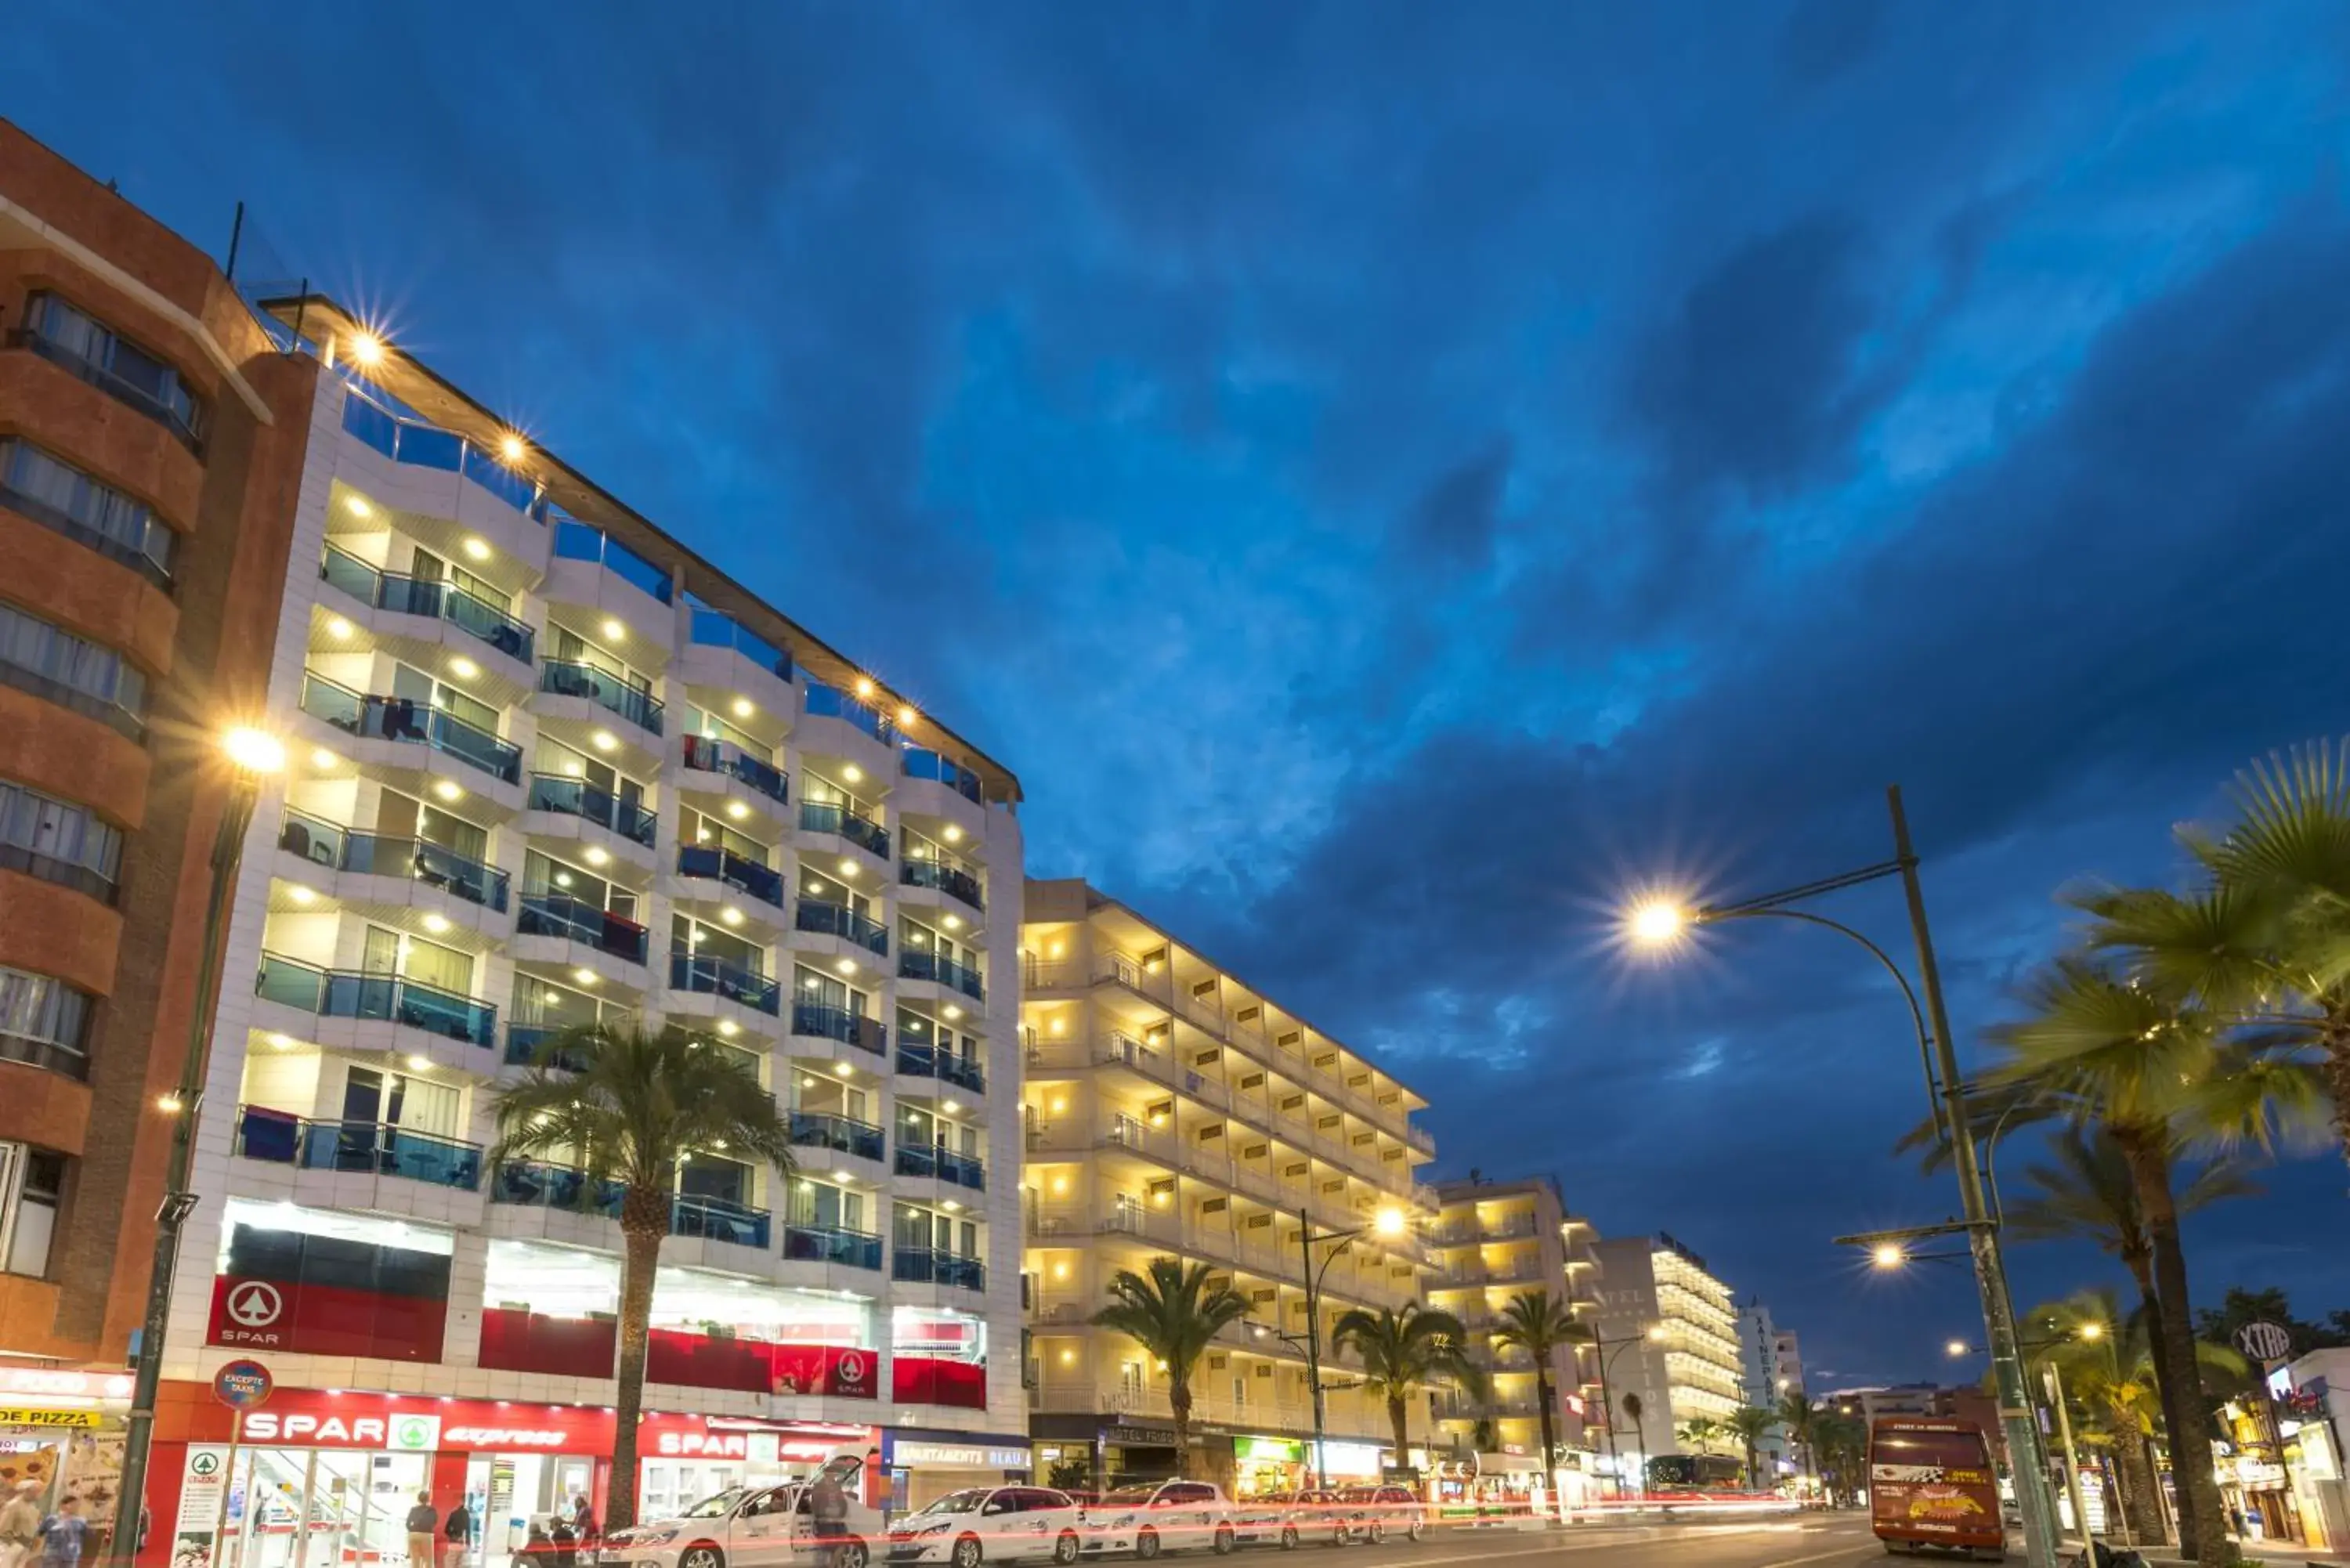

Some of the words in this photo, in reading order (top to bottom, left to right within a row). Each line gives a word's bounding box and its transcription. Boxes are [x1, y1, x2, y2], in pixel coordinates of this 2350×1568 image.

[222, 1329, 279, 1345] SPAR
[2240, 1321, 2290, 1359] XTRA
[837, 1383, 865, 1393] SPAR
[30, 1412, 89, 1425] PIZZA
[244, 1413, 385, 1442] SPAR
[443, 1425, 566, 1446] express
[659, 1433, 745, 1454] SPAR
[901, 1447, 983, 1465] APARTAMENTS
